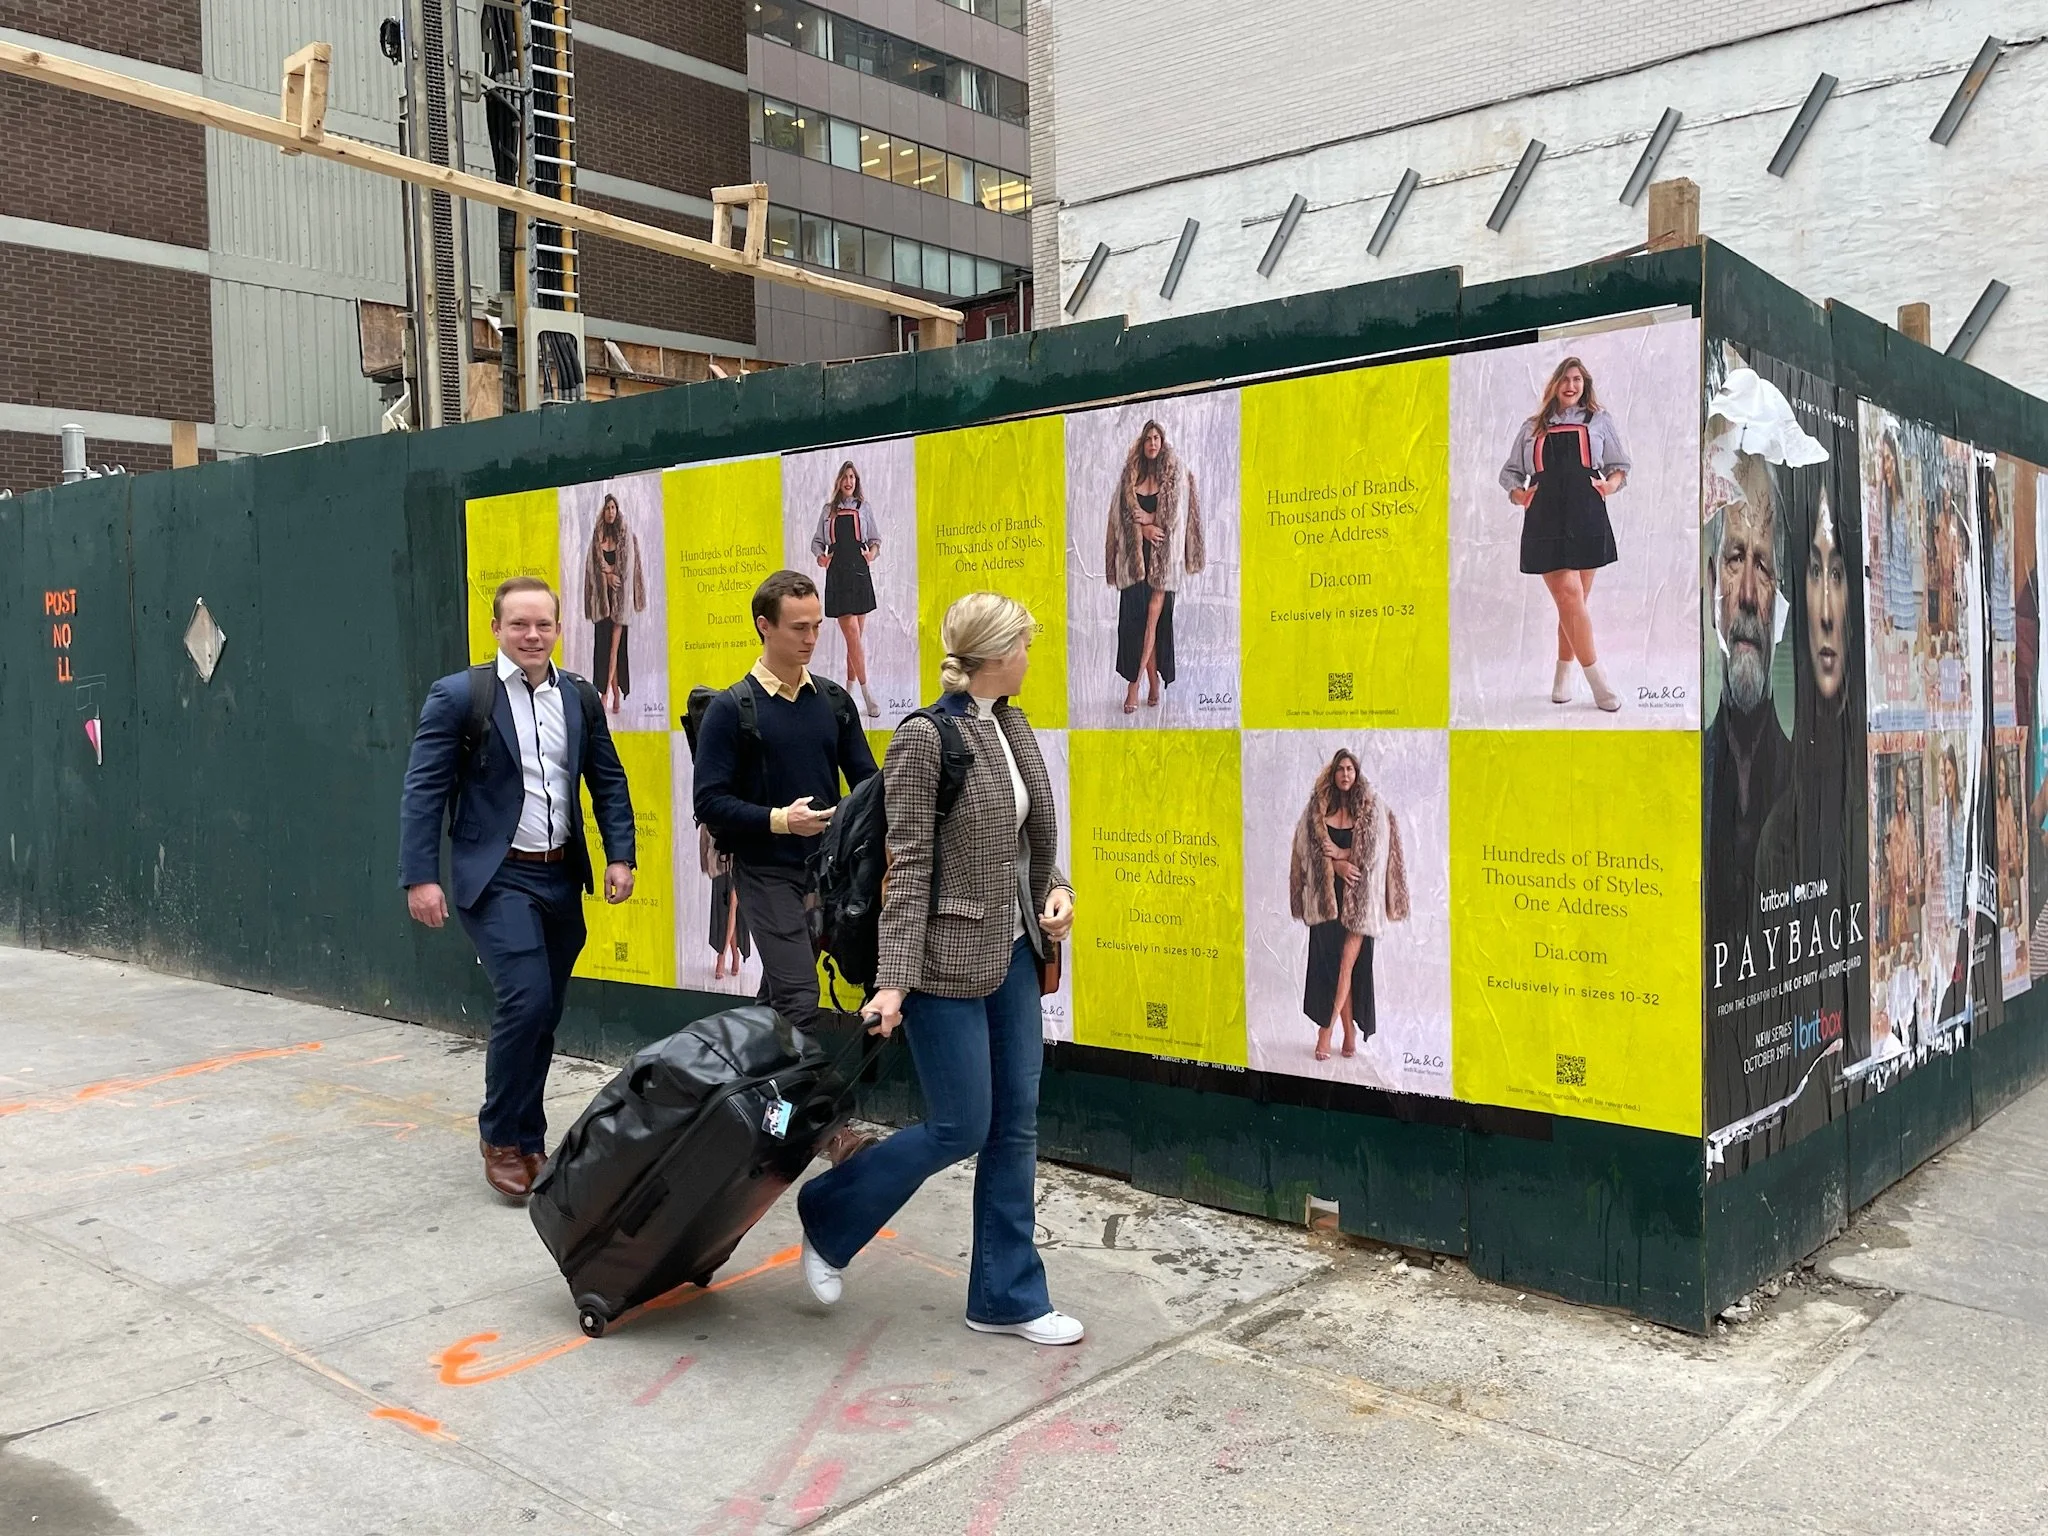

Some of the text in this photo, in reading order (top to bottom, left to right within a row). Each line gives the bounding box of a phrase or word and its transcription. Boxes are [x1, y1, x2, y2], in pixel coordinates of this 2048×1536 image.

[1267, 476, 1419, 505] Hundreds of Brands,
[1267, 500, 1418, 526] Thousands of Styles,
[936, 521, 986, 538] Hundreds
[990, 518, 1003, 532] of
[1294, 524, 1389, 546] One Address
[680, 546, 722, 562] Hundreds
[724, 545, 734, 558] of
[936, 539, 993, 556] Thousands
[997, 536, 1009, 551] of
[680, 563, 727, 578] Thousands
[729, 561, 740, 574] of
[955, 557, 1025, 573] One Address
[697, 578, 752, 593] One Address
[1309, 571, 1372, 588] Dia.com
[45, 588, 77, 616] POST
[707, 612, 743, 625] Dia.com
[1270, 604, 1415, 622] Exclusively in sizes 10-32
[53, 623, 72, 649] NO
[684, 640, 720, 651] Exclusively
[723, 640, 729, 649] in
[730, 640, 747, 648] sizes
[1215, 692, 1223, 704] &
[1223, 692, 1233, 704] Co
[1637, 686, 1685, 700] Dia & Co
[1092, 826, 1220, 847] Hundreds of Brands,
[1092, 846, 1220, 868] Thousands of Styles,
[1481, 844, 1664, 873] Hundreds of Brands,
[1115, 867, 1196, 887] One Address
[1481, 867, 1663, 898] Thousands of Styles,
[1514, 892, 1628, 919] One Address
[1760, 887, 1790, 913] britbox
[1129, 907, 1184, 926] Dia.com
[1096, 937, 1219, 959] Exclusively in sizes 10-32
[1534, 941, 1608, 965] Dia.com
[1713, 901, 1865, 989] PAYBACK
[1487, 975, 1660, 1006] Exclusively in sizes 10-32
[1717, 1001, 1734, 1017] FROM
[1735, 997, 1746, 1011] THE
[1746, 988, 1771, 1007] CREATOR
[1771, 986, 1778, 998] OF
[1779, 979, 1793, 996] LINE
[1793, 975, 1802, 990] OF
[1802, 969, 1818, 987] DUTY
[1755, 1007, 1842, 1051] NEW SERIES britbox
[1403, 1052, 1443, 1067] Dia & Co
[1743, 1047, 1775, 1075] OCTOBER
[1538, 1090, 1552, 1098] Your
[1553, 1092, 1581, 1103] curiosity
[1582, 1096, 1593, 1104] will
[1594, 1098, 1604, 1106] be
